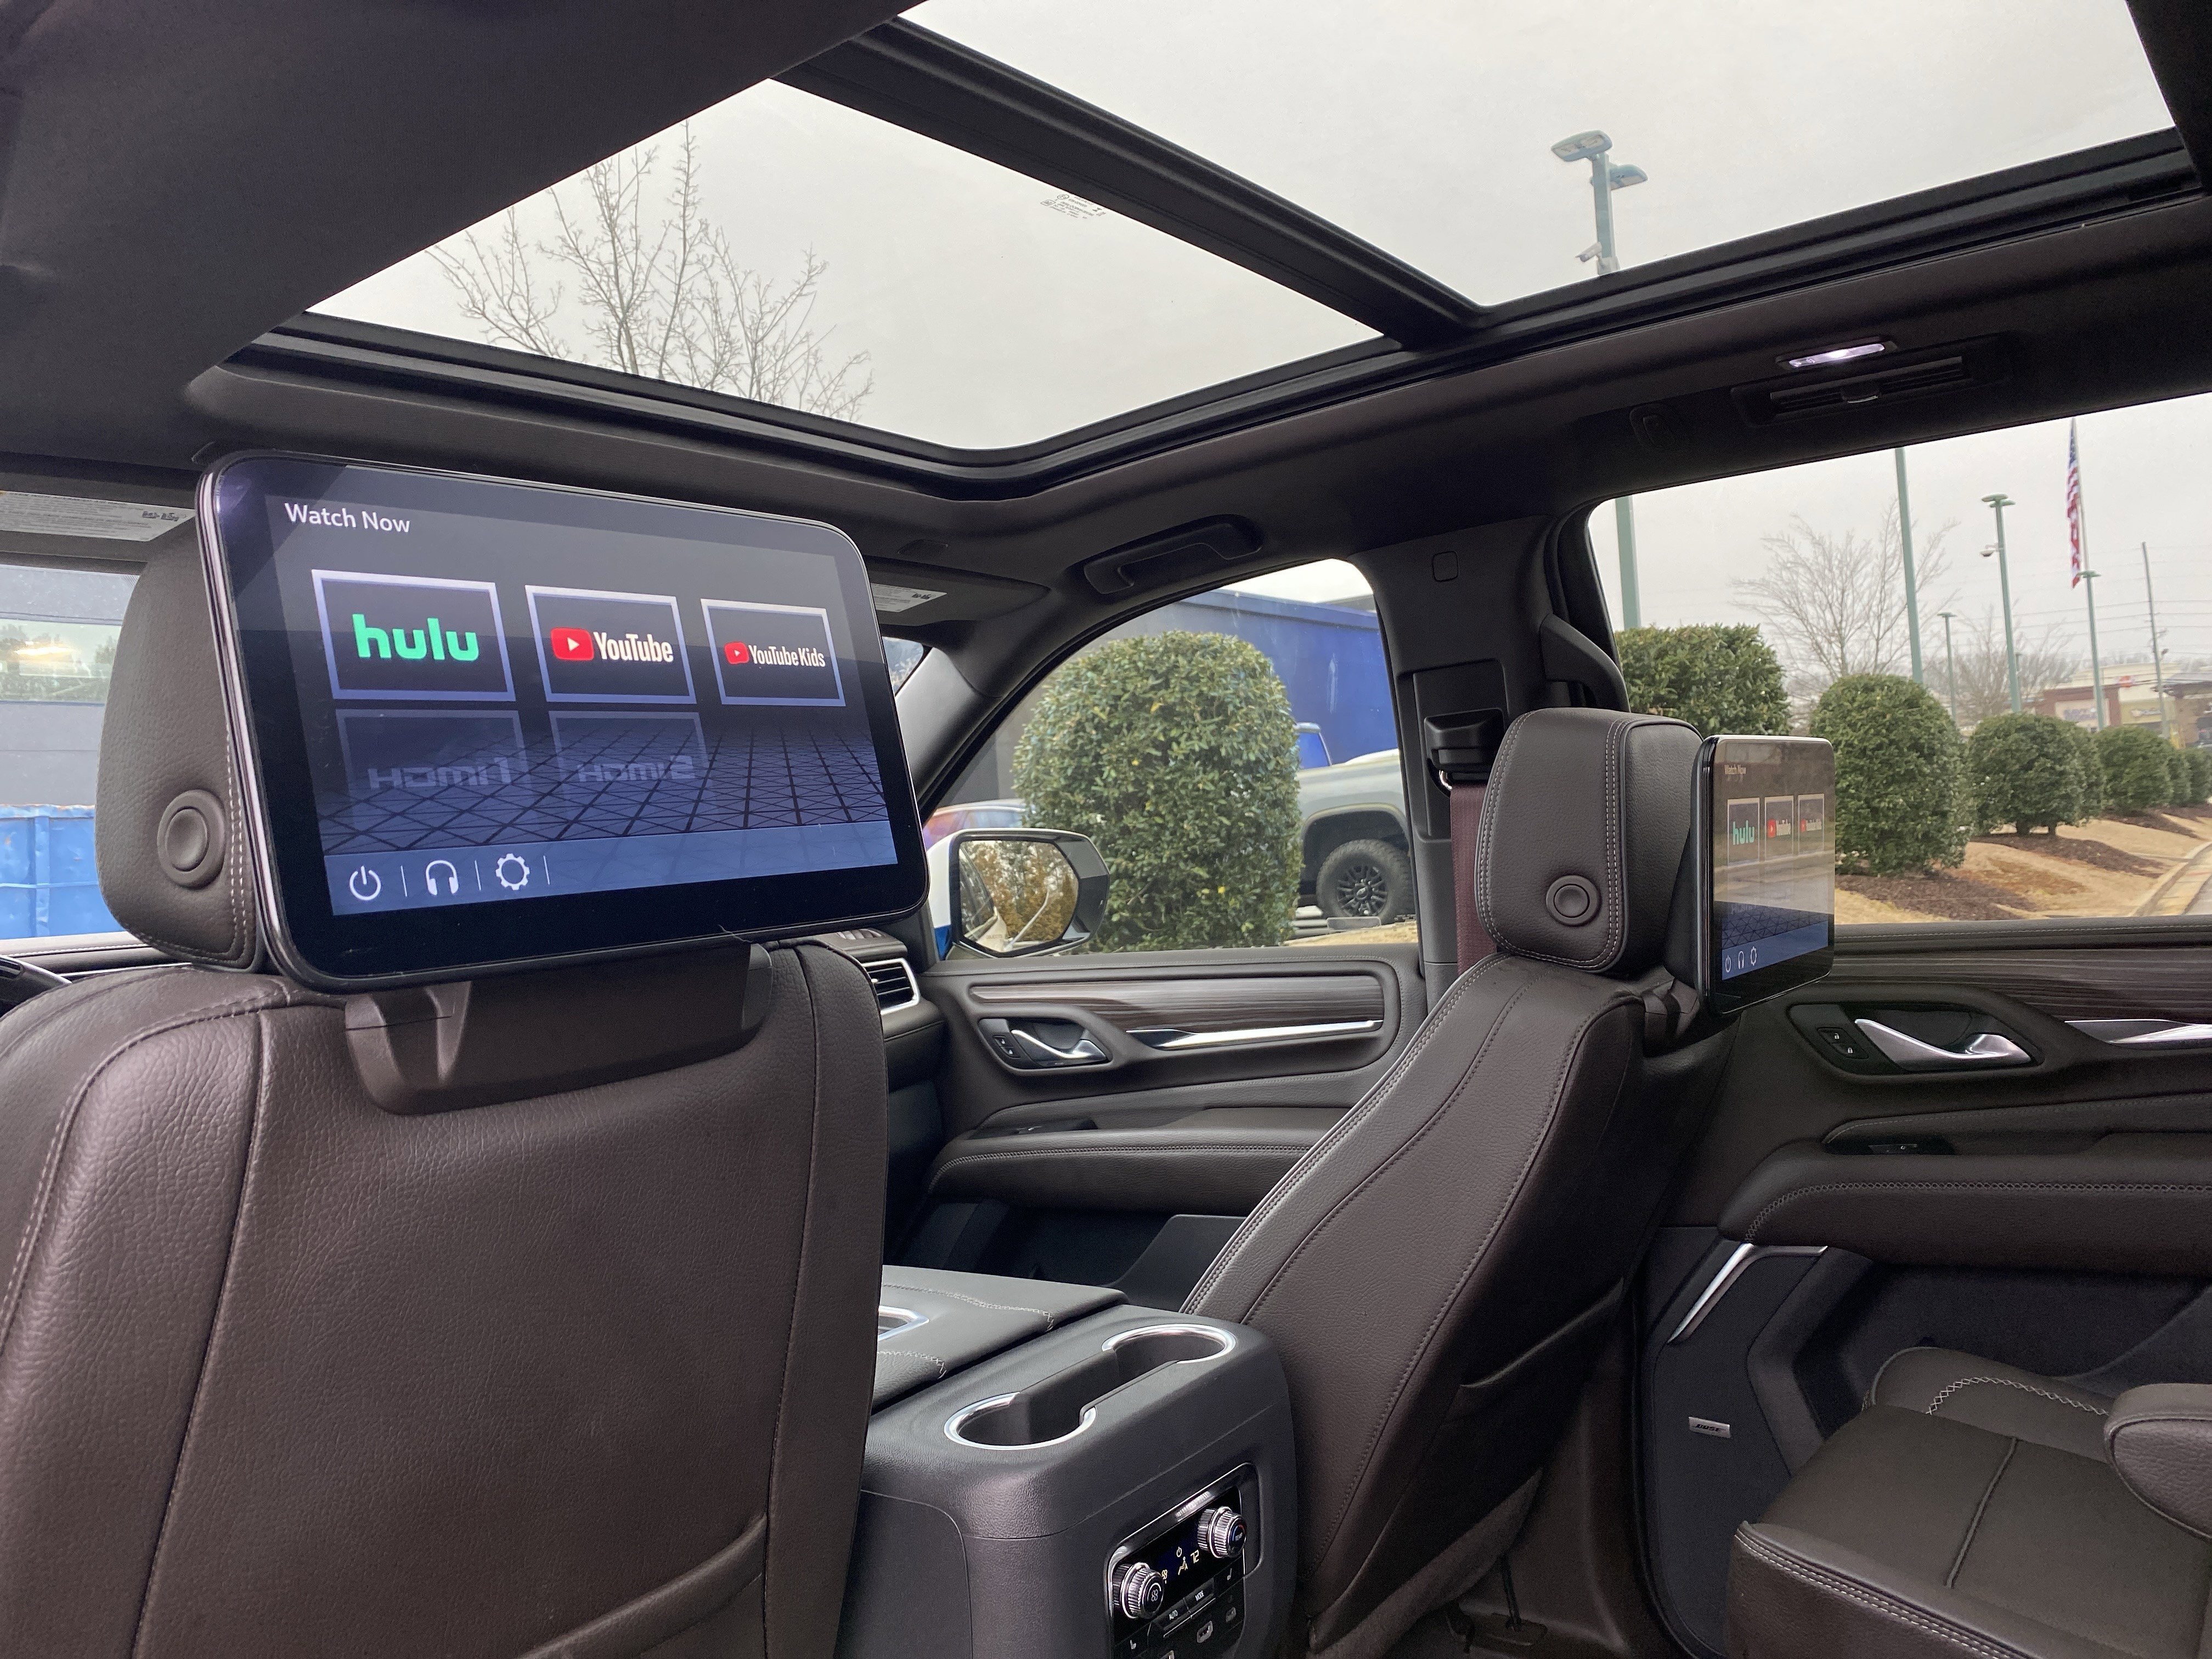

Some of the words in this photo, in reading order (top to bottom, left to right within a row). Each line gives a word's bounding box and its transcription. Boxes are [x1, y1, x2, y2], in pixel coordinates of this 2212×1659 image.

[284, 503, 357, 528] Watch
[362, 511, 410, 533] Now
[352, 613, 479, 662] hulu
[593, 631, 674, 662] YouTube
[748, 645, 799, 665] YouTube
[799, 648, 826, 668] Kids
[1732, 820, 1755, 845] hulu
[1190, 1549, 1200, 1564] 72
